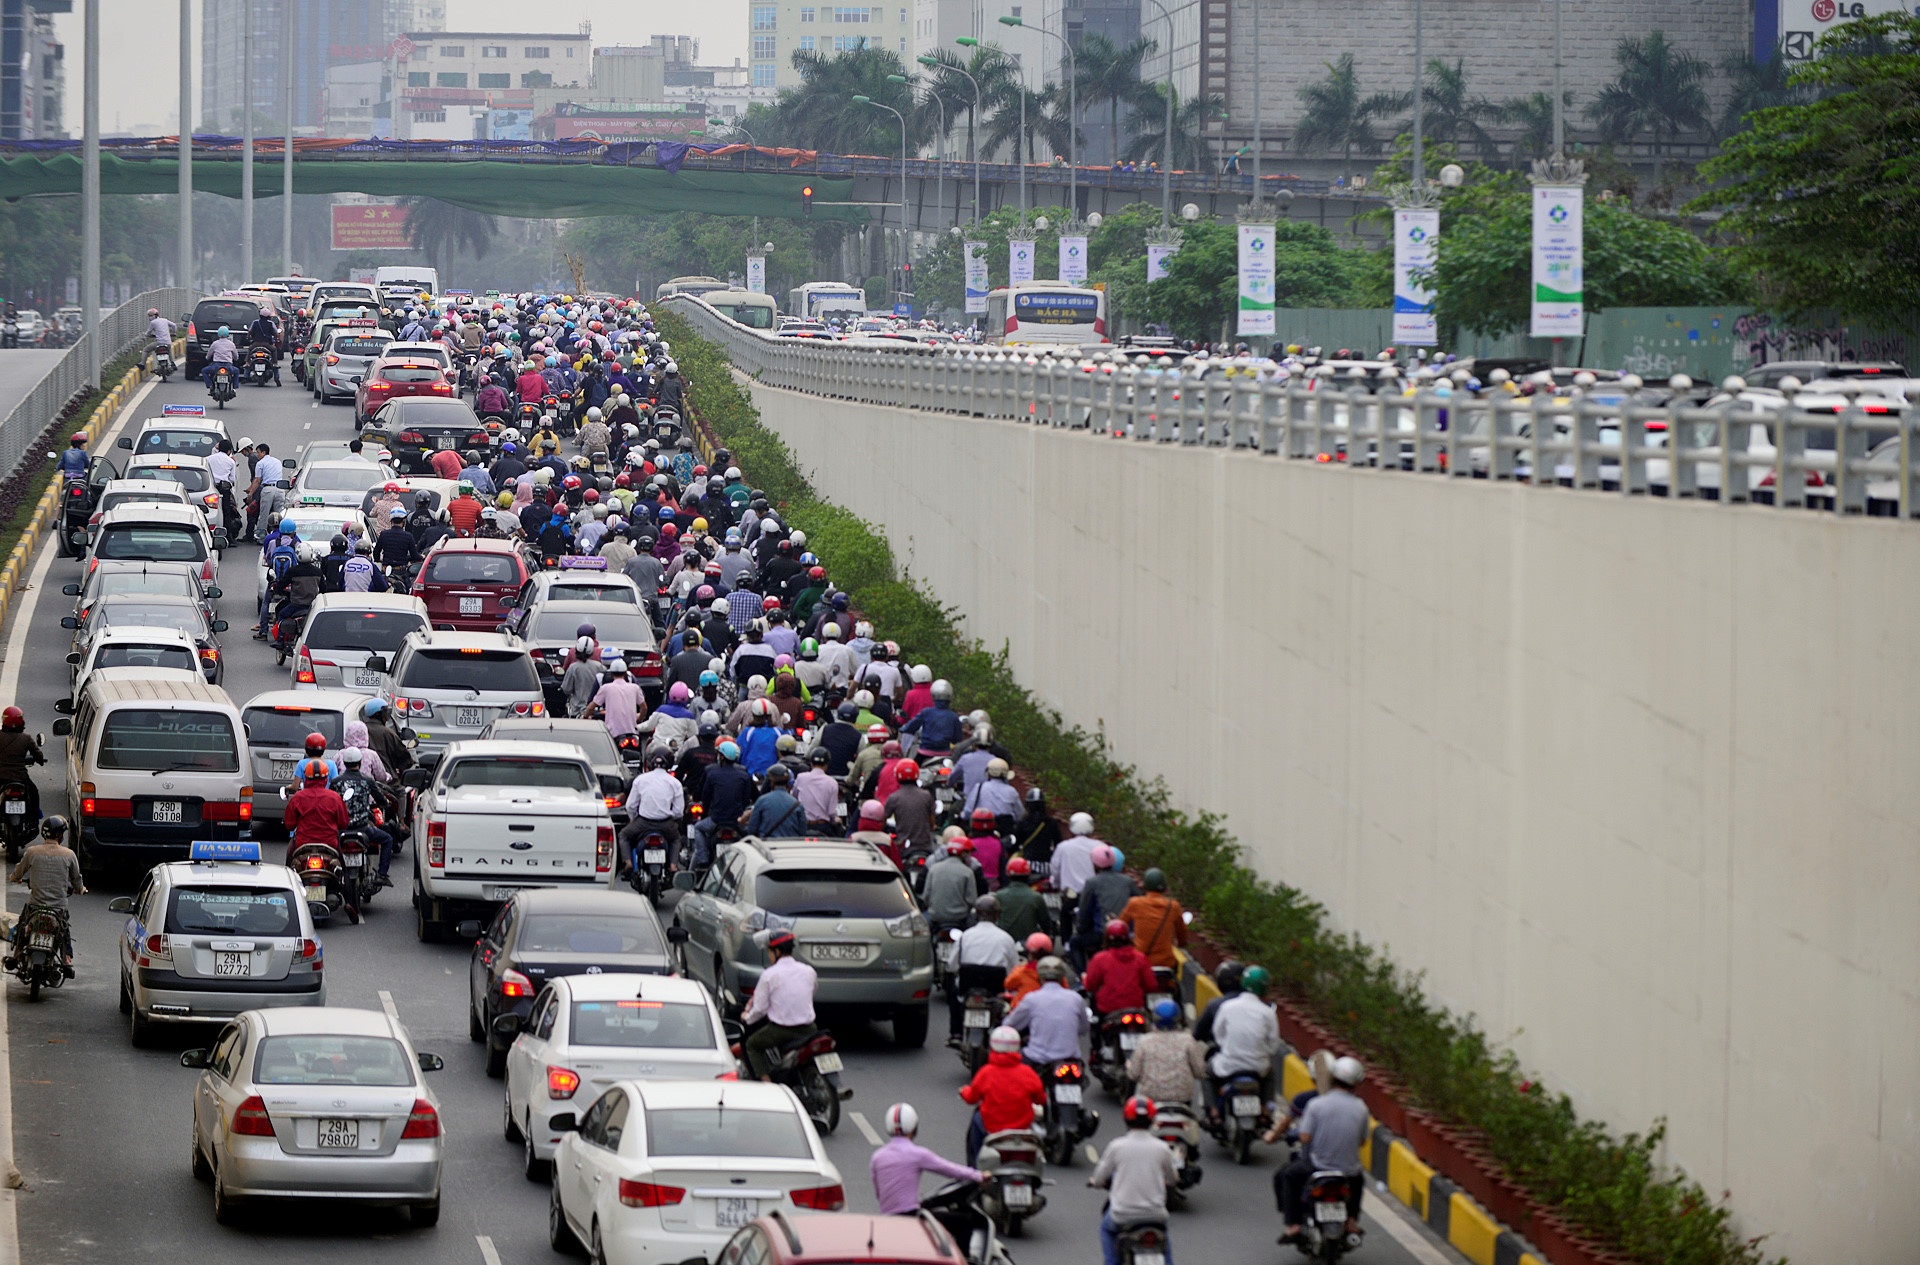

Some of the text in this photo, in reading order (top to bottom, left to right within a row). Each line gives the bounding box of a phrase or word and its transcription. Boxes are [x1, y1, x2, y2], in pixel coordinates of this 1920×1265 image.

[1839, 3, 1864, 17] LG
[158, 722, 226, 733] HIACE
[280, 761, 294, 770] 29A
[274, 770, 294, 779] 742.7
[160, 802, 176, 812] 29D
[154, 812, 181, 821] 091.08
[451, 857, 589, 868] RANGER
[224, 954, 242, 964] 29A
[217, 964, 248, 975] 027.72
[328, 1121, 348, 1133] 29A
[320, 1134, 357, 1146] 798.07
[727, 1198, 748, 1212] 29A
